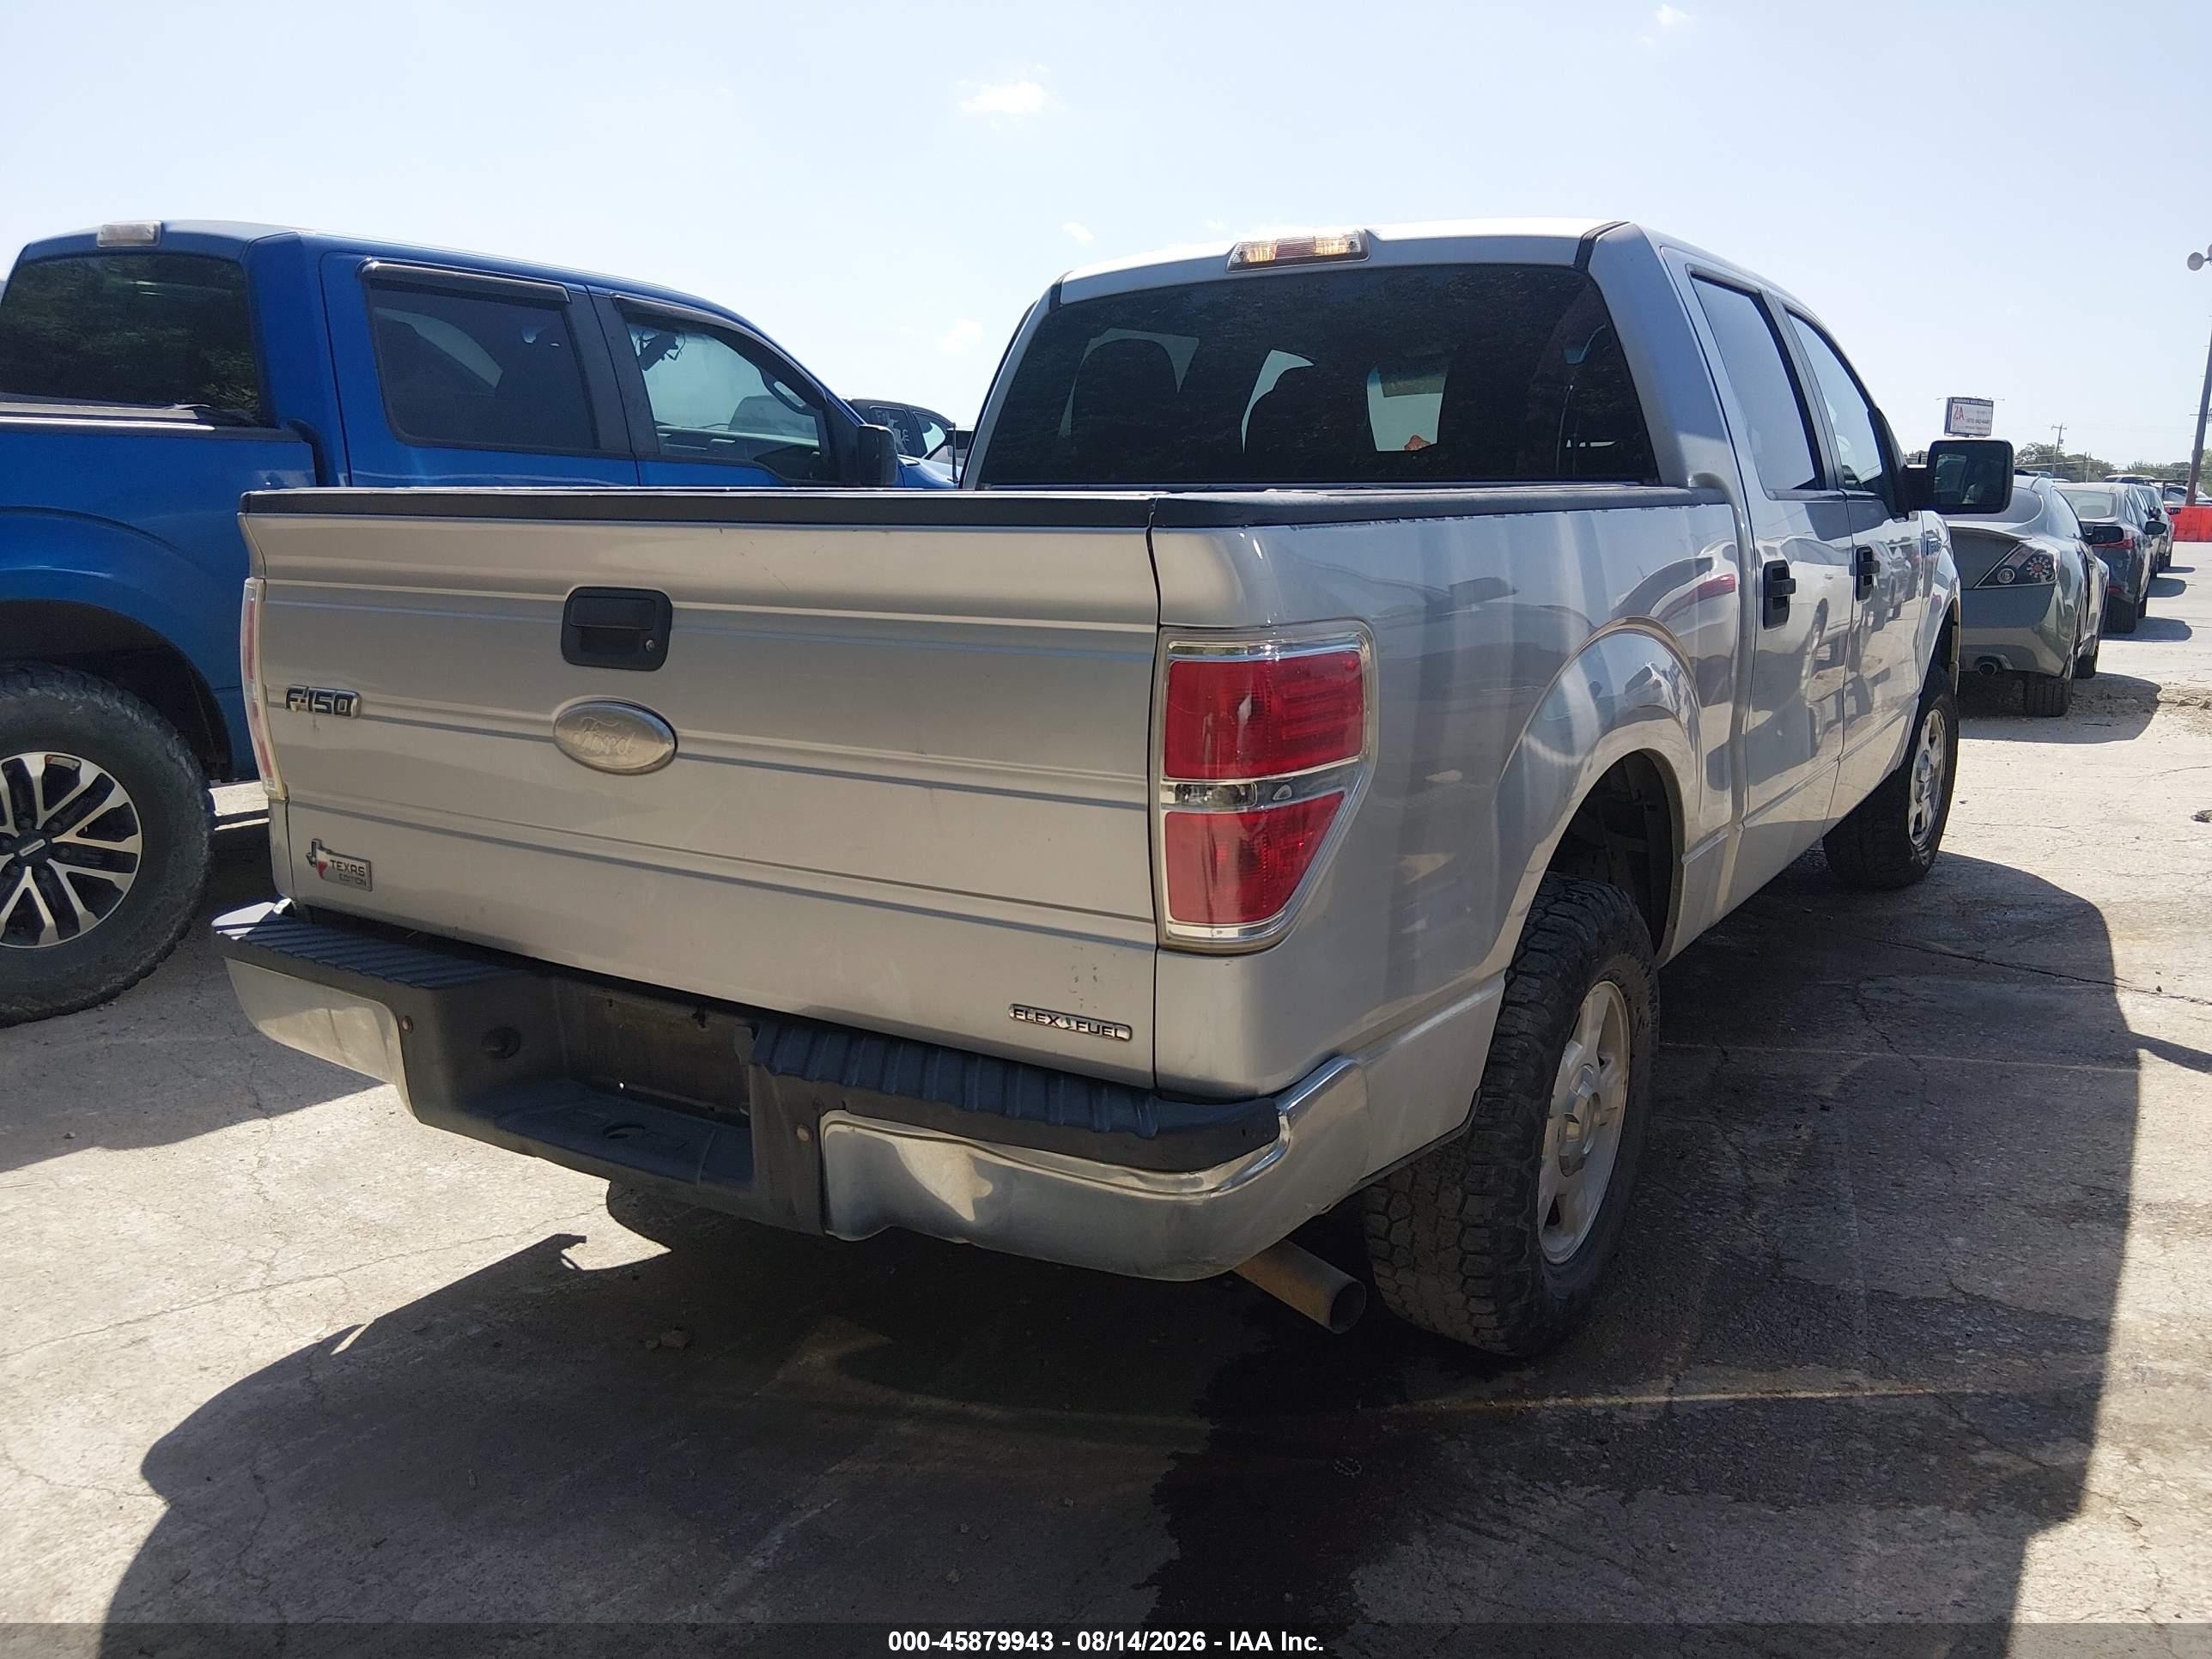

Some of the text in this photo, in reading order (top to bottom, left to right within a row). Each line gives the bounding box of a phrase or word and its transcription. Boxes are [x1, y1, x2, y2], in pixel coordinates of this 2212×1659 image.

[573, 716, 635, 757] Ford
[330, 859, 366, 878] TEXAS
[1013, 1008, 1129, 1041] FLEX FUEL
